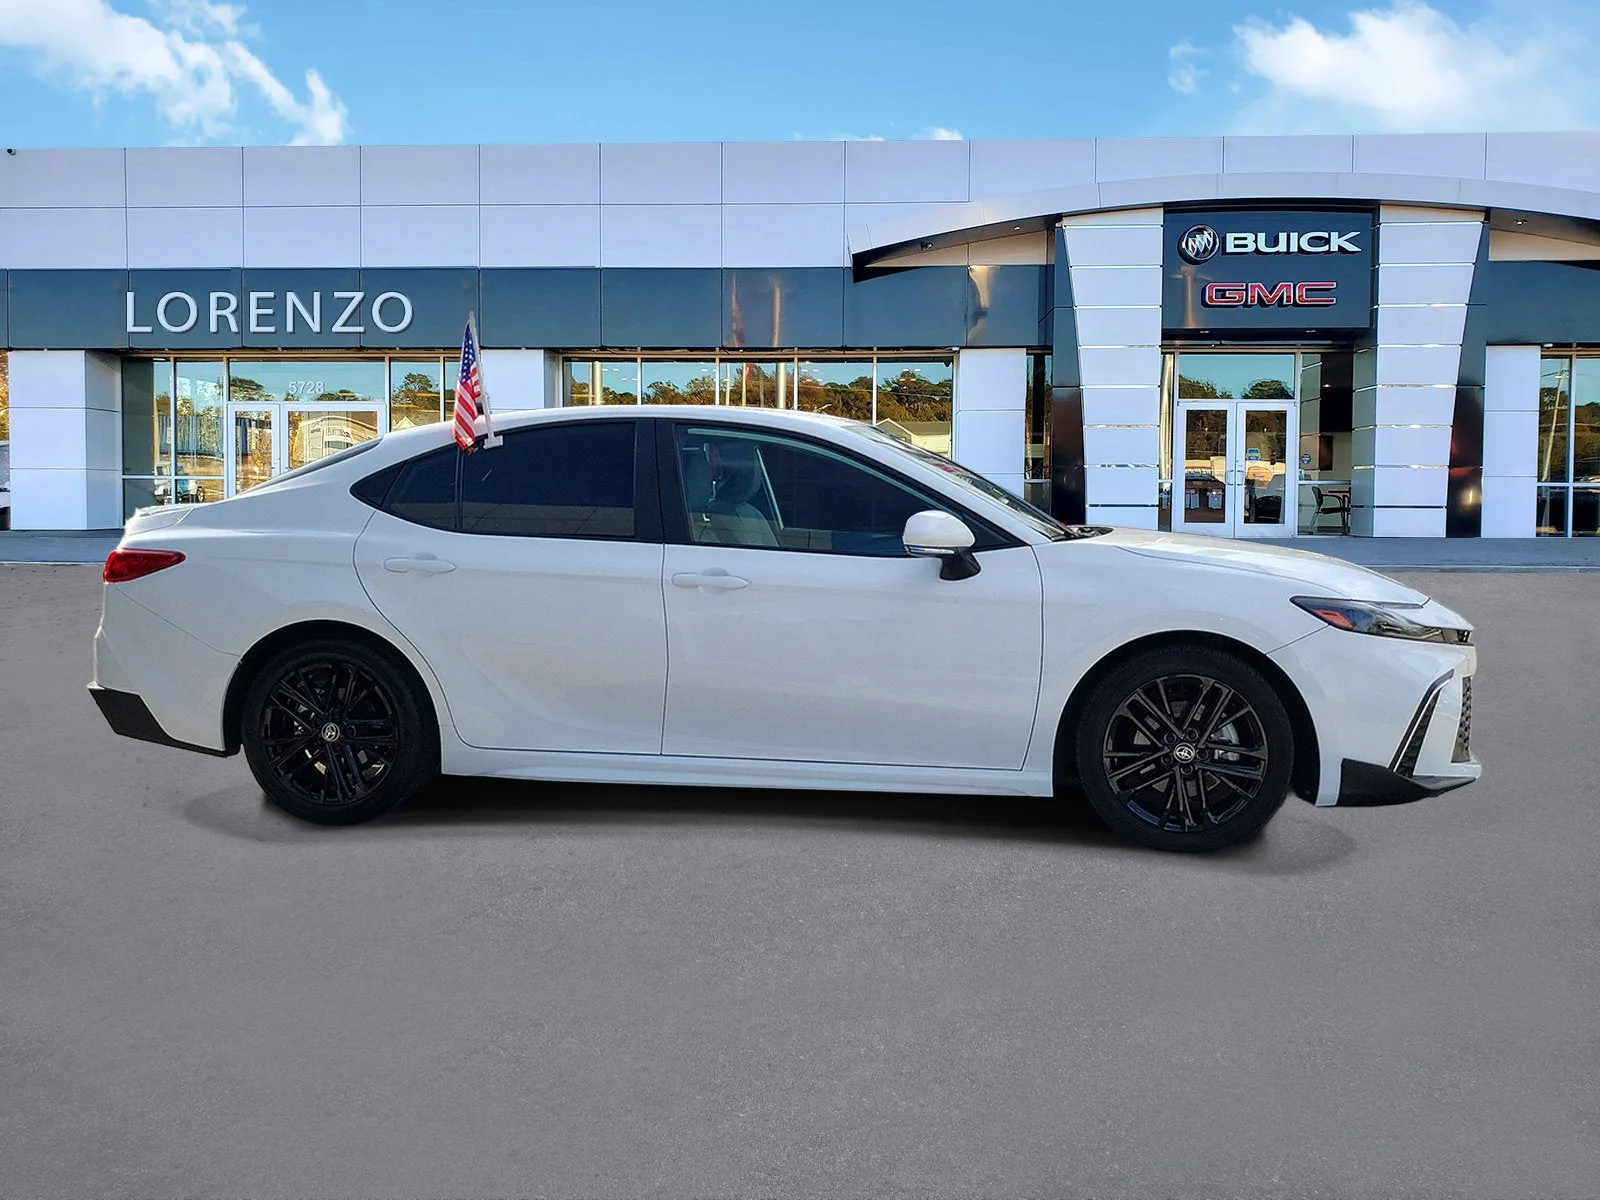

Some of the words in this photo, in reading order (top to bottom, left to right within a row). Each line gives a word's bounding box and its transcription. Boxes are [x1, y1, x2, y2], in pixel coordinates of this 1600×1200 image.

[1225, 231, 1362, 253] BUICK
[1206, 281, 1337, 305] GMC
[126, 291, 413, 333] LORENZO
[288, 380, 325, 394] 5728
